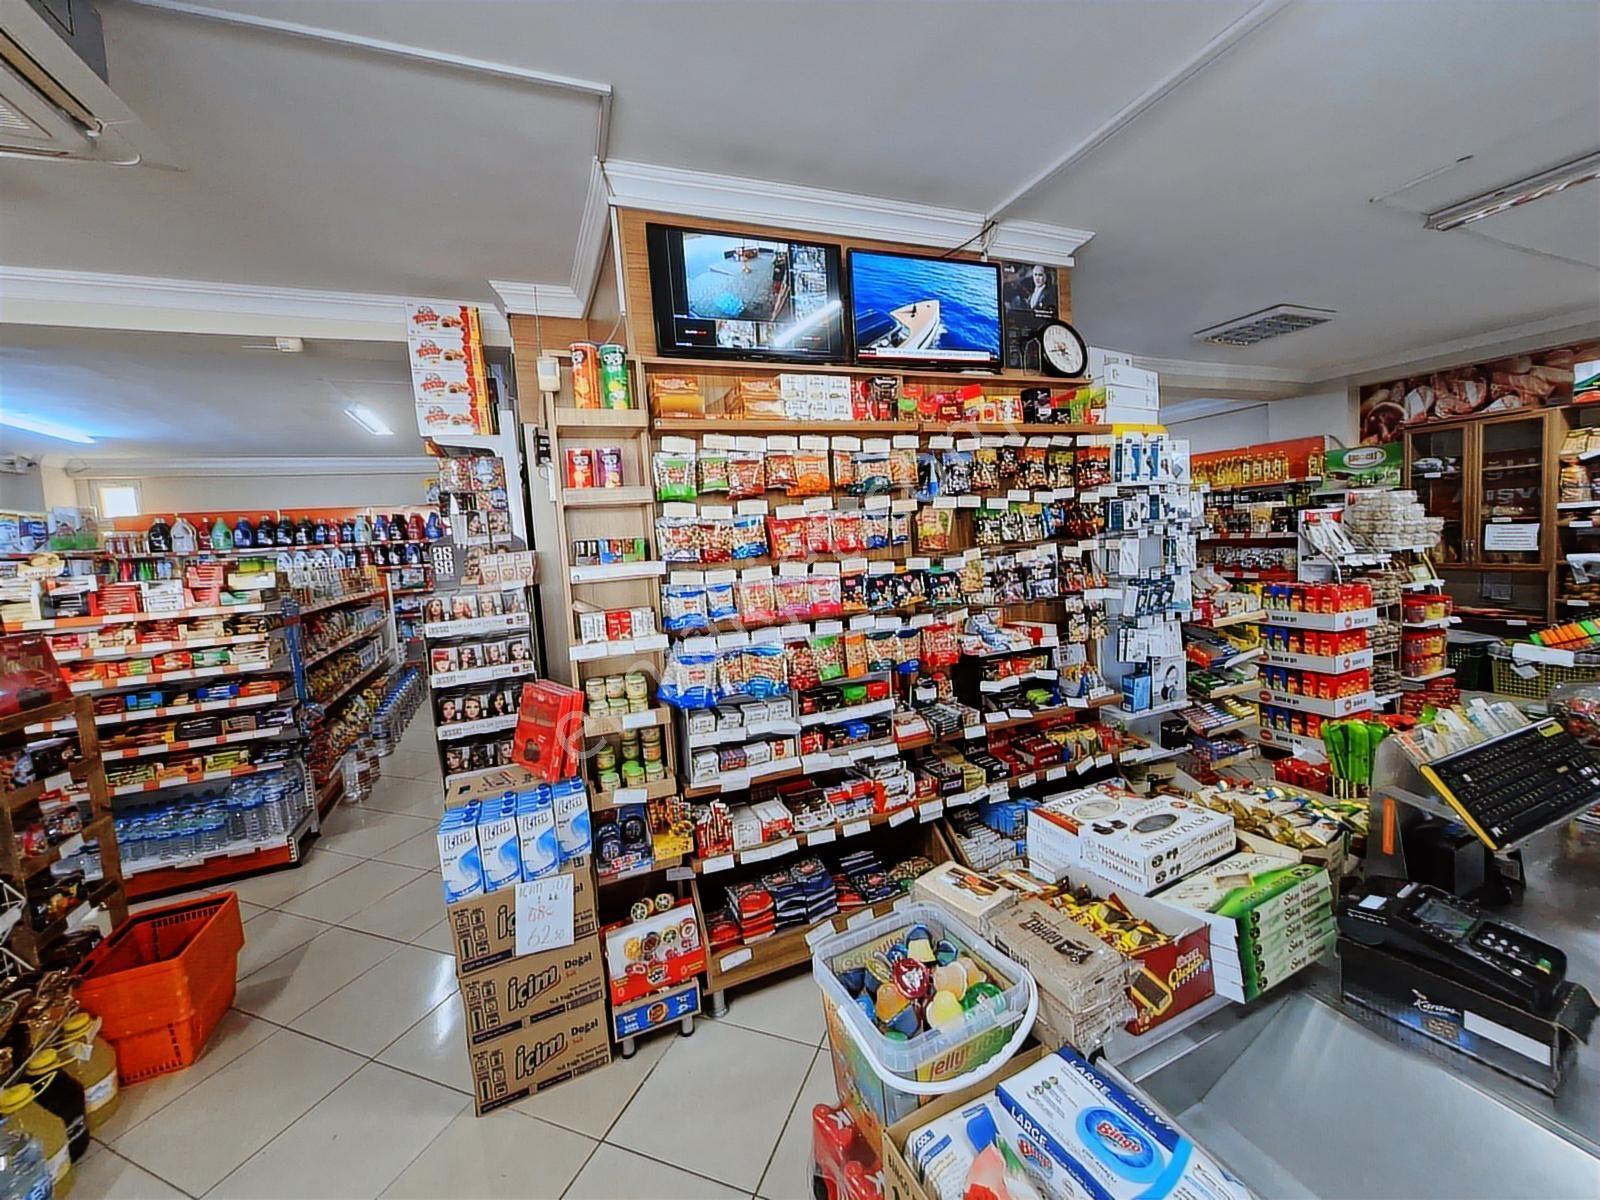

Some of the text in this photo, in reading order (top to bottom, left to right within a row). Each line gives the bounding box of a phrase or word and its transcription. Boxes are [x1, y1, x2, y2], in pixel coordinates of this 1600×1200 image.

[432, 546, 453, 561] as
[434, 560, 454, 575] se
[564, 952, 592, 970] Doğal
[571, 1018, 598, 1036] Doğal
[1070, 1060, 1111, 1097] LARGE
[1011, 1105, 1049, 1150] LARGE
[1096, 1119, 1143, 1155] Bingo
